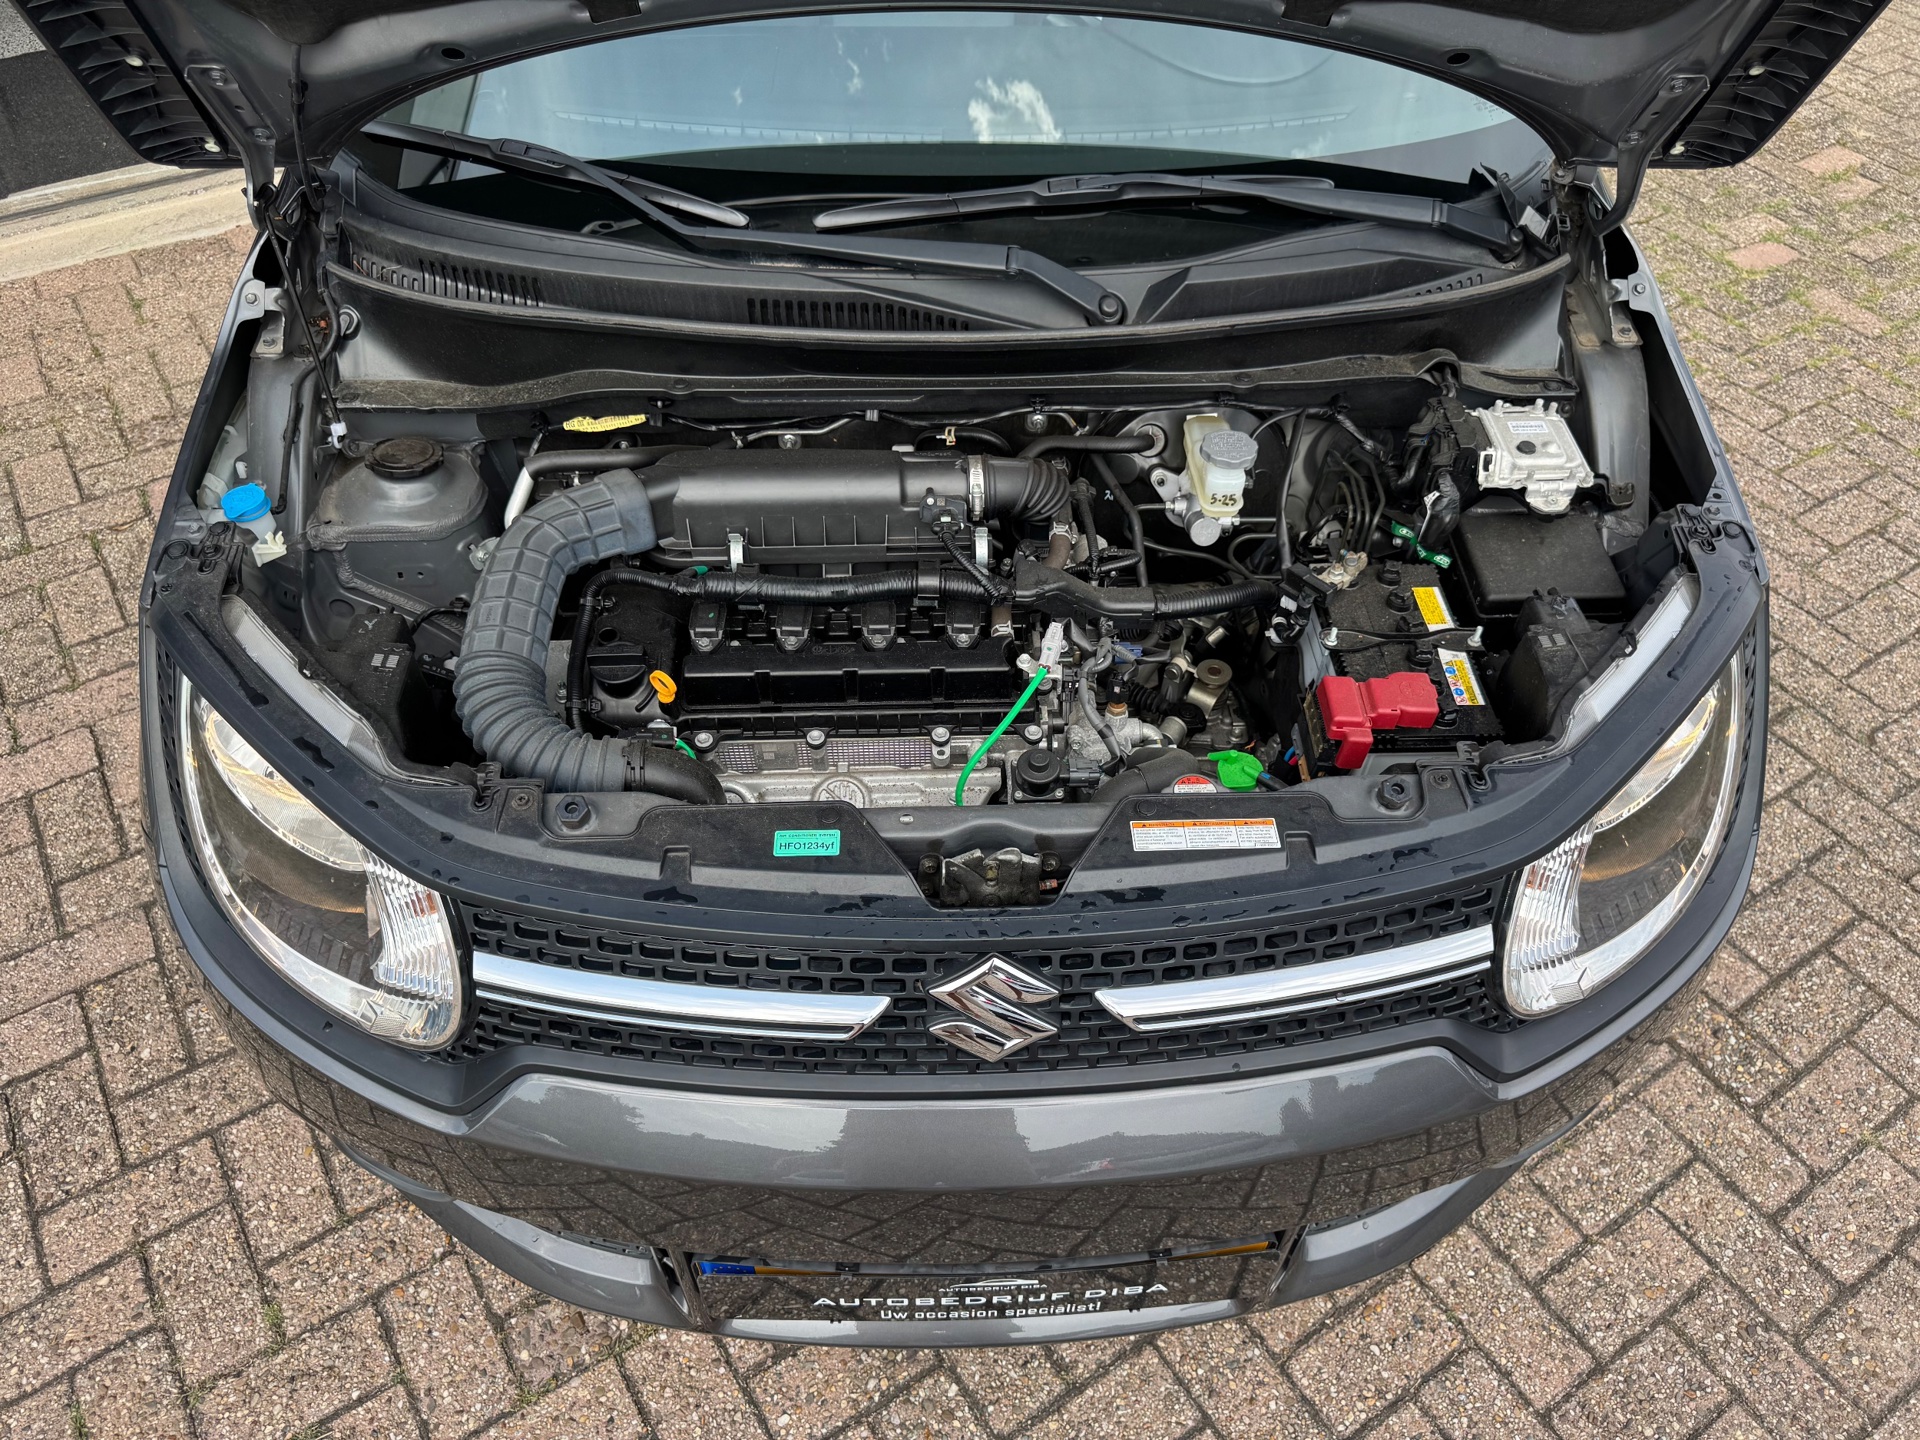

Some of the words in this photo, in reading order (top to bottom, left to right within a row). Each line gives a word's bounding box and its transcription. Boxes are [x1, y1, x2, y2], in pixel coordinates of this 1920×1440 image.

[779, 841, 835, 851] HFO1234yf
[813, 1291, 1071, 1306] AUTOBEDRIJF
[1084, 1283, 1169, 1299] DIBA
[880, 1310, 908, 1319] Uw
[915, 1308, 998, 1319] occasion
[1005, 1301, 1102, 1317] specialist!
